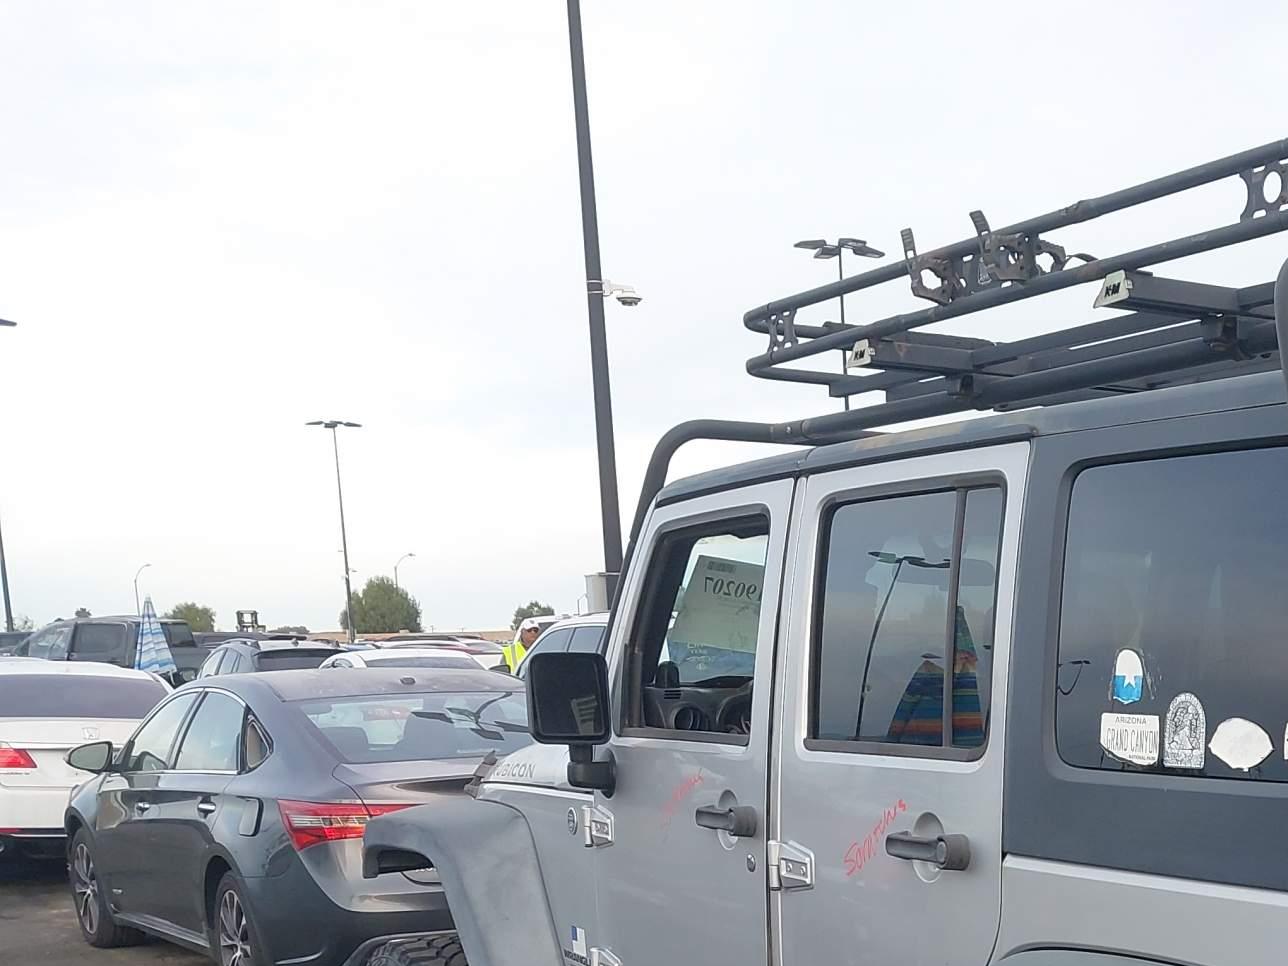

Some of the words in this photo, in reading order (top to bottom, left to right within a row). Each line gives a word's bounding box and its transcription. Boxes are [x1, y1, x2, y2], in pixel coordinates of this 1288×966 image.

[1114, 716, 1147, 725] ARIZONA
[1106, 727, 1129, 752] GRAND
[1130, 728, 1159, 754] CANYON
